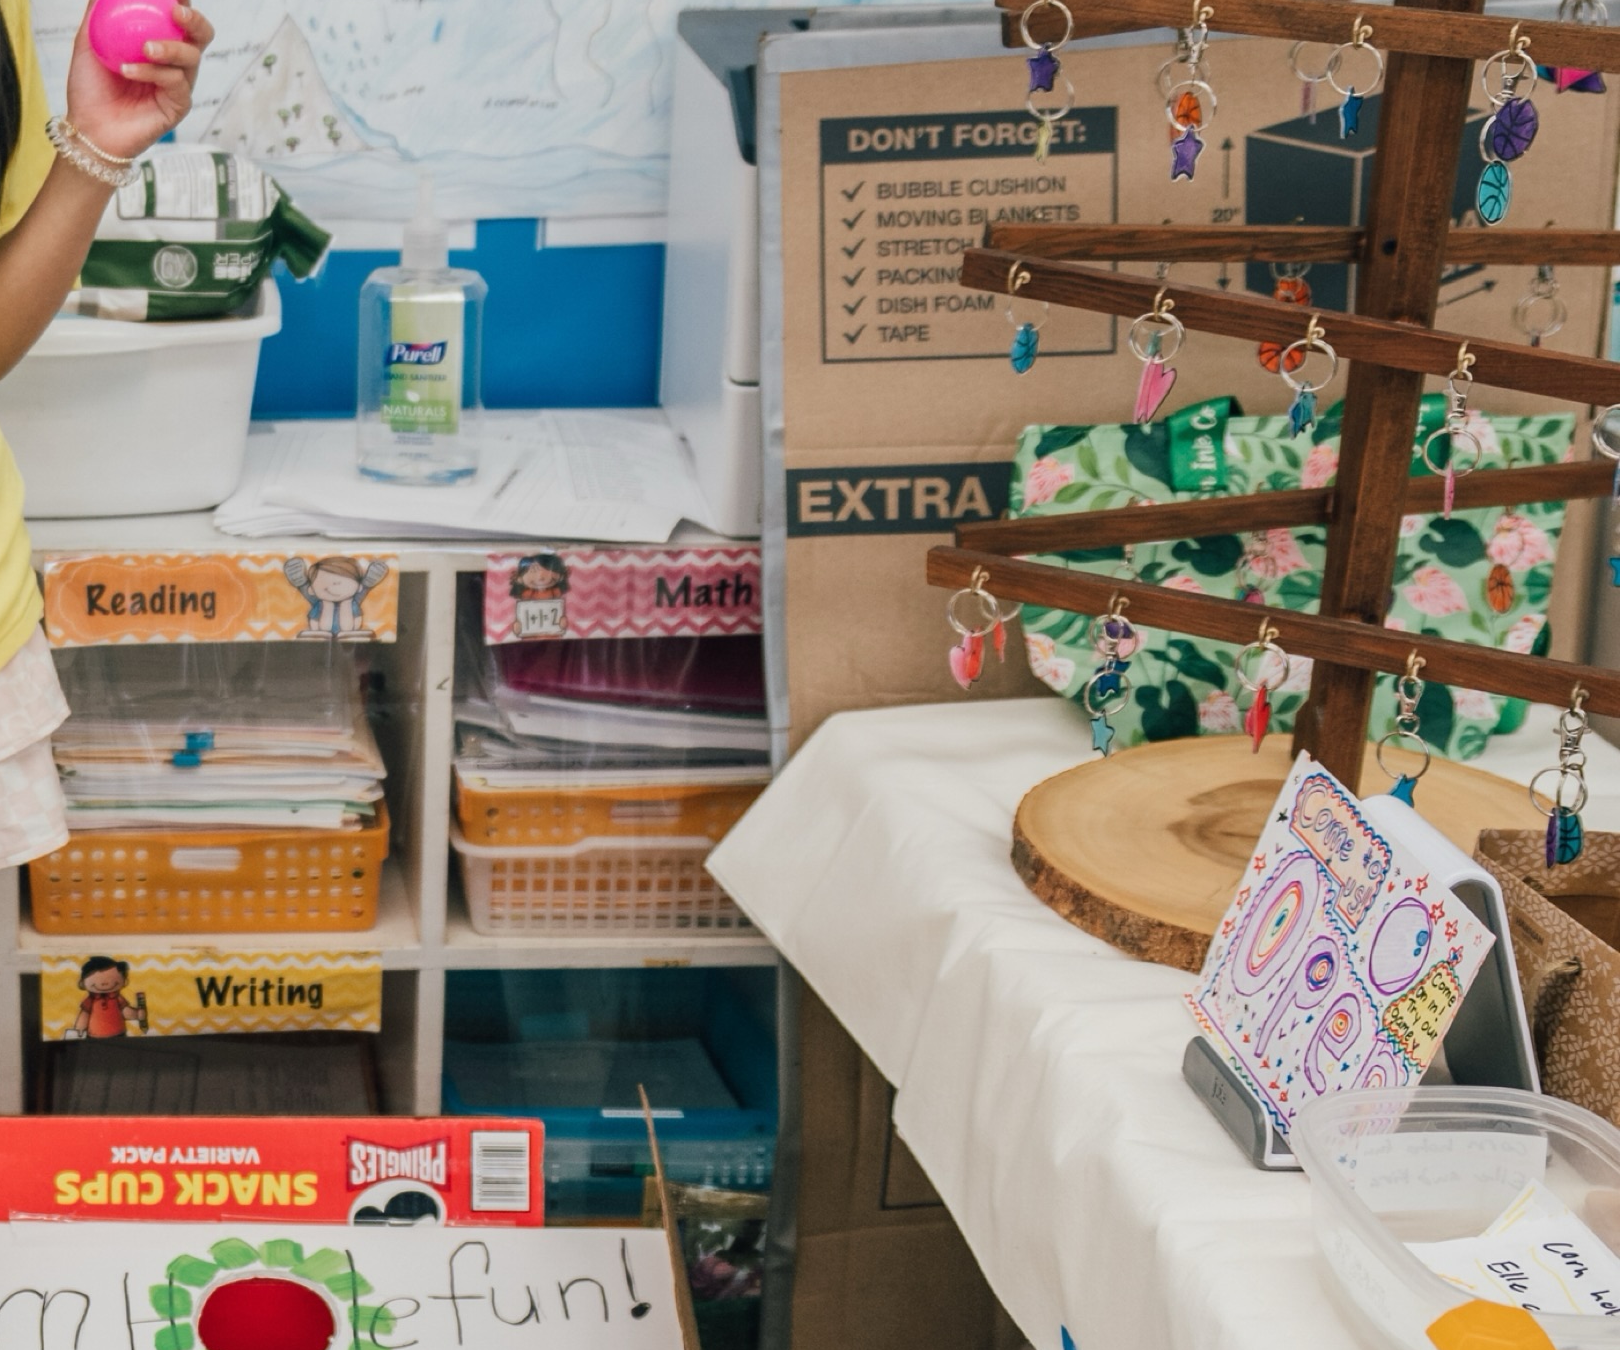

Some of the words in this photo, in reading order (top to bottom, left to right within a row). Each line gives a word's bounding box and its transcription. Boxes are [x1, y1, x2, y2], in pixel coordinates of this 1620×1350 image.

[847, 124, 945, 153] DON'T
[876, 181, 963, 200] BUBBLE
[968, 176, 1067, 197] CUSHION
[877, 208, 963, 229] MOVING
[967, 203, 1081, 225] BLANKETS
[1211, 207, 1242, 224] 20"
[877, 295, 928, 315] DISH
[932, 293, 996, 314] FOAM
[877, 324, 931, 344] TAPE
[390, 343, 443, 363] Purell
[382, 403, 448, 418] NATURALS
[797, 475, 993, 523] EXTRA
[85, 582, 217, 618] Reading
[653, 573, 755, 610] Math
[1299, 782, 1356, 862] Come
[196, 974, 325, 1012] Writing
[1431, 972, 1457, 1008] Come
[1407, 997, 1422, 1025] Try
[111, 1146, 171, 1164] PACK
[178, 1146, 261, 1164] VARIETY
[348, 1140, 452, 1188] PRINGLES
[54, 1171, 165, 1206] CUPS
[173, 1171, 319, 1206] SNACK
[1543, 1242, 1589, 1279] Corn
[426, 1236, 652, 1347] fun!
